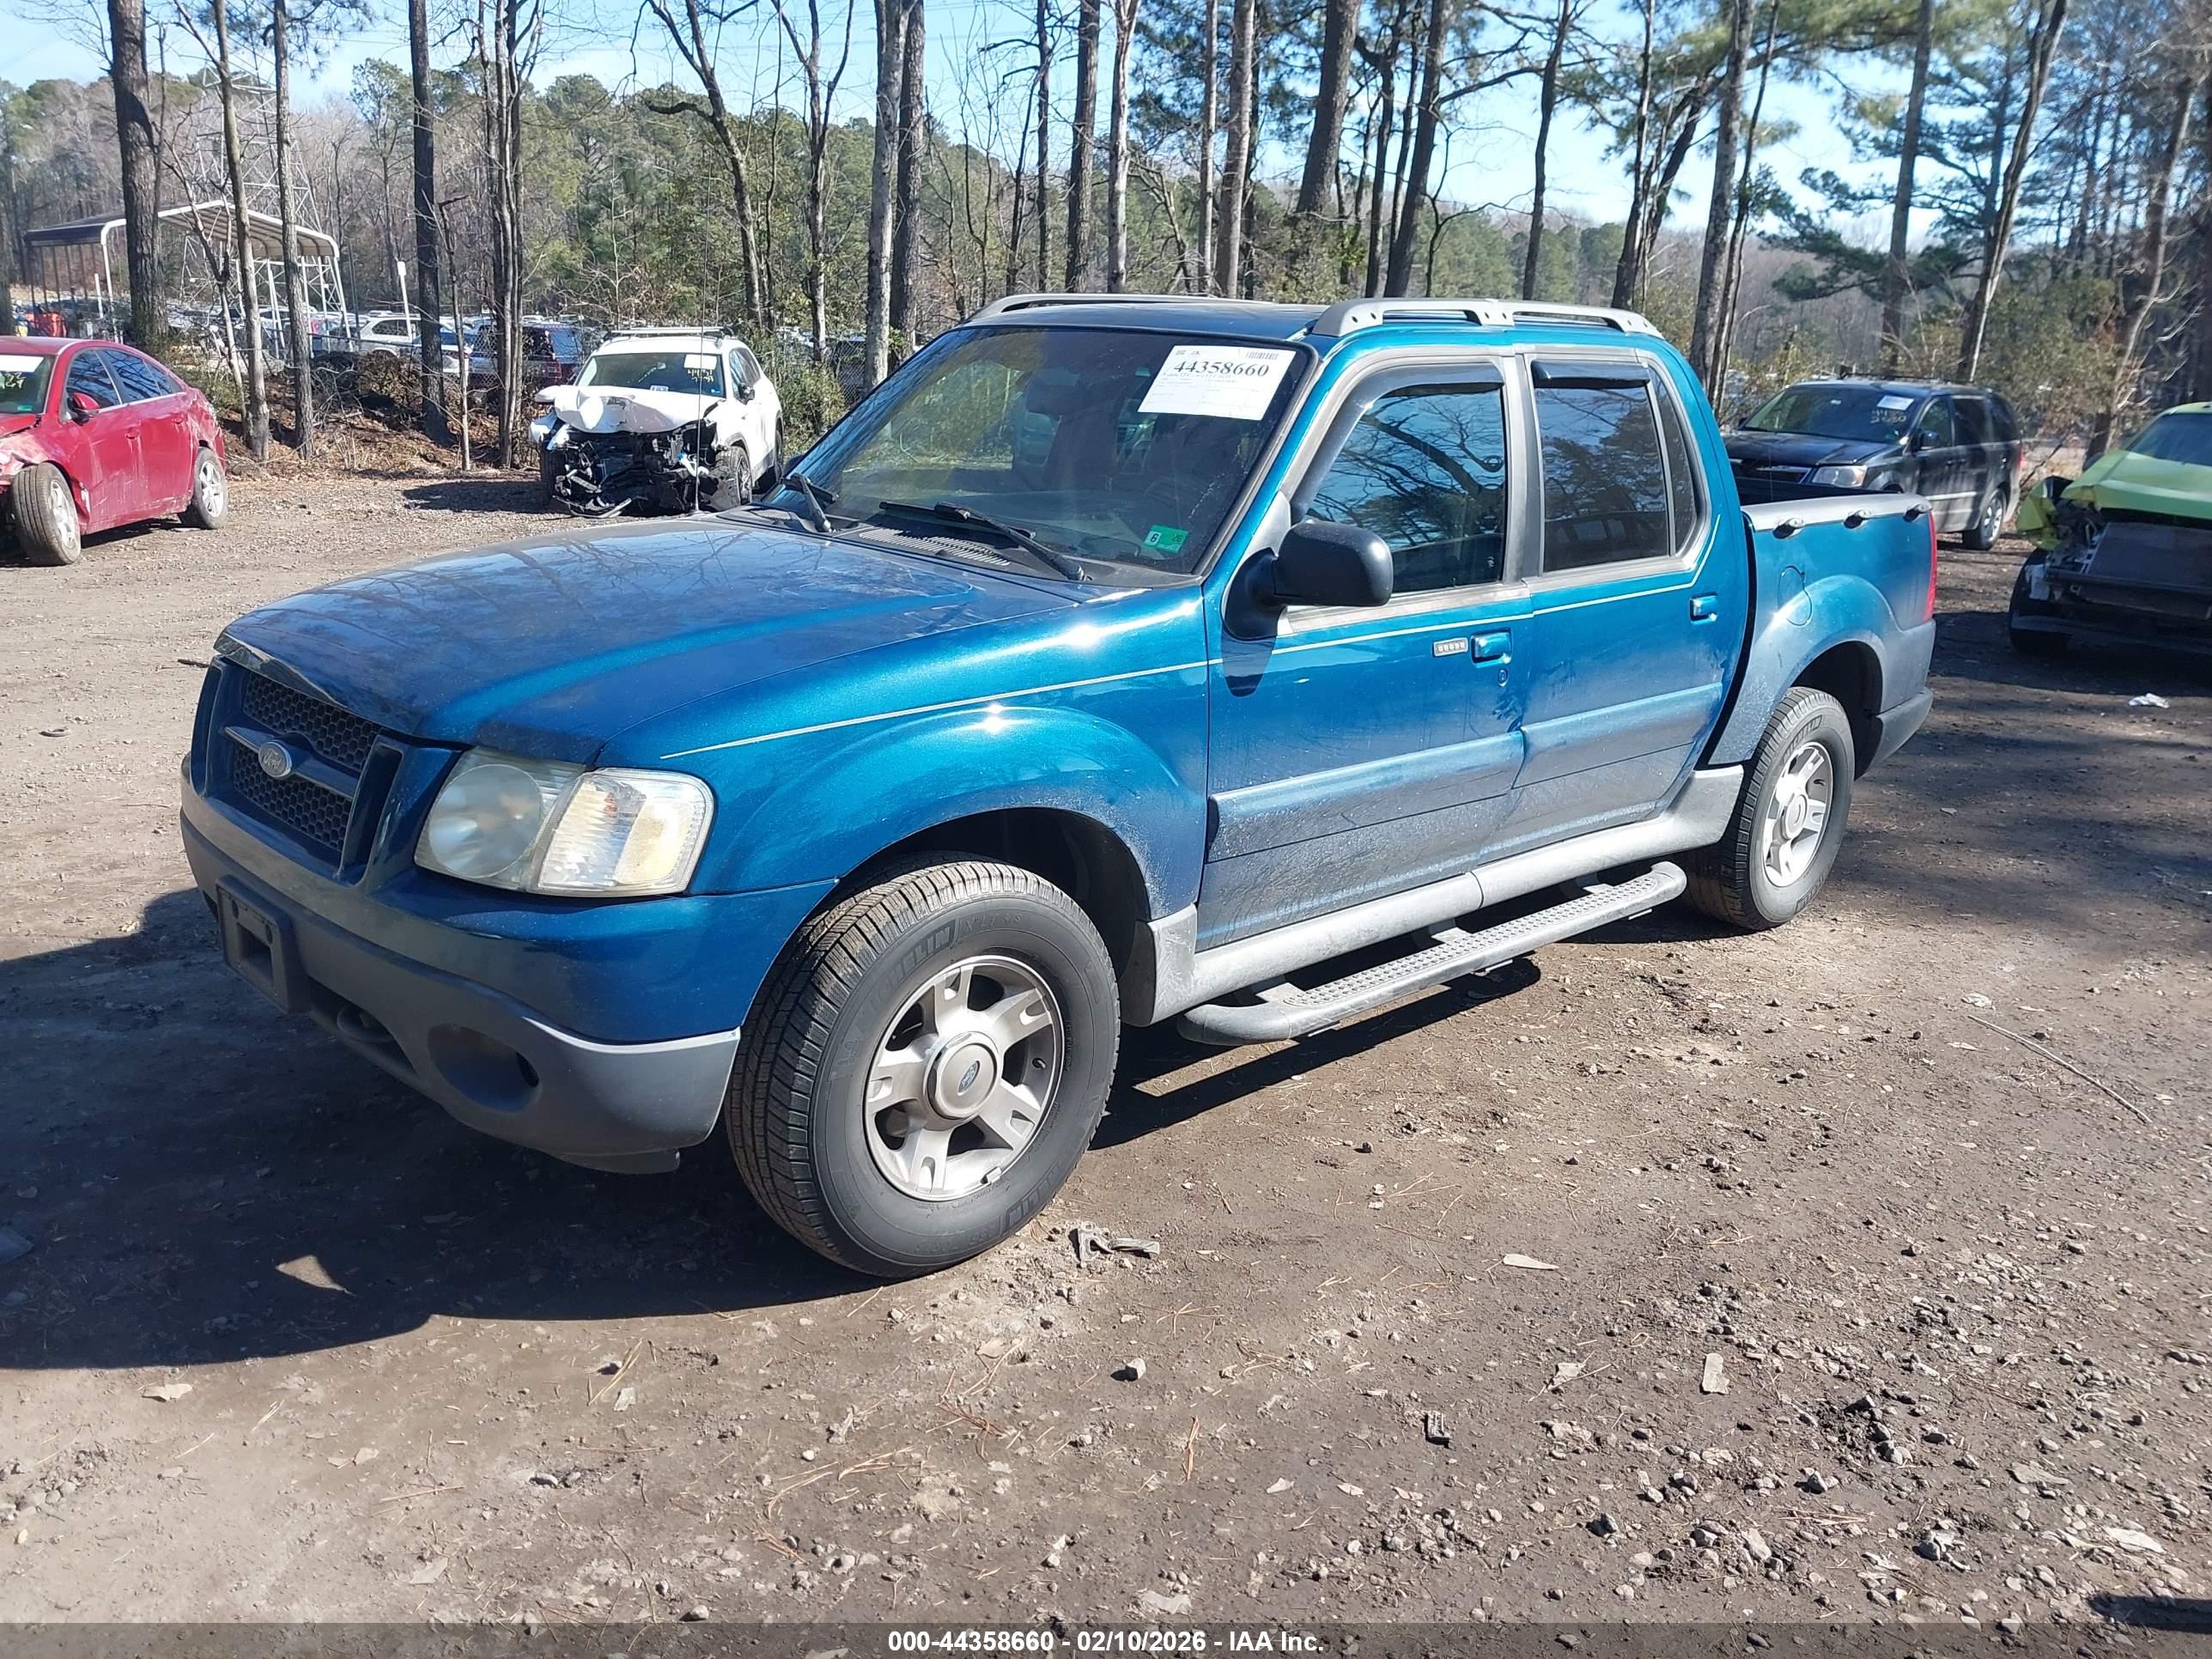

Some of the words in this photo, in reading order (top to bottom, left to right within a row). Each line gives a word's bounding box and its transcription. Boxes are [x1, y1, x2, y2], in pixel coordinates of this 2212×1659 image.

[1174, 361, 1269, 377] 44358660
[1150, 533, 1159, 543] 6
[263, 748, 282, 769] Ford
